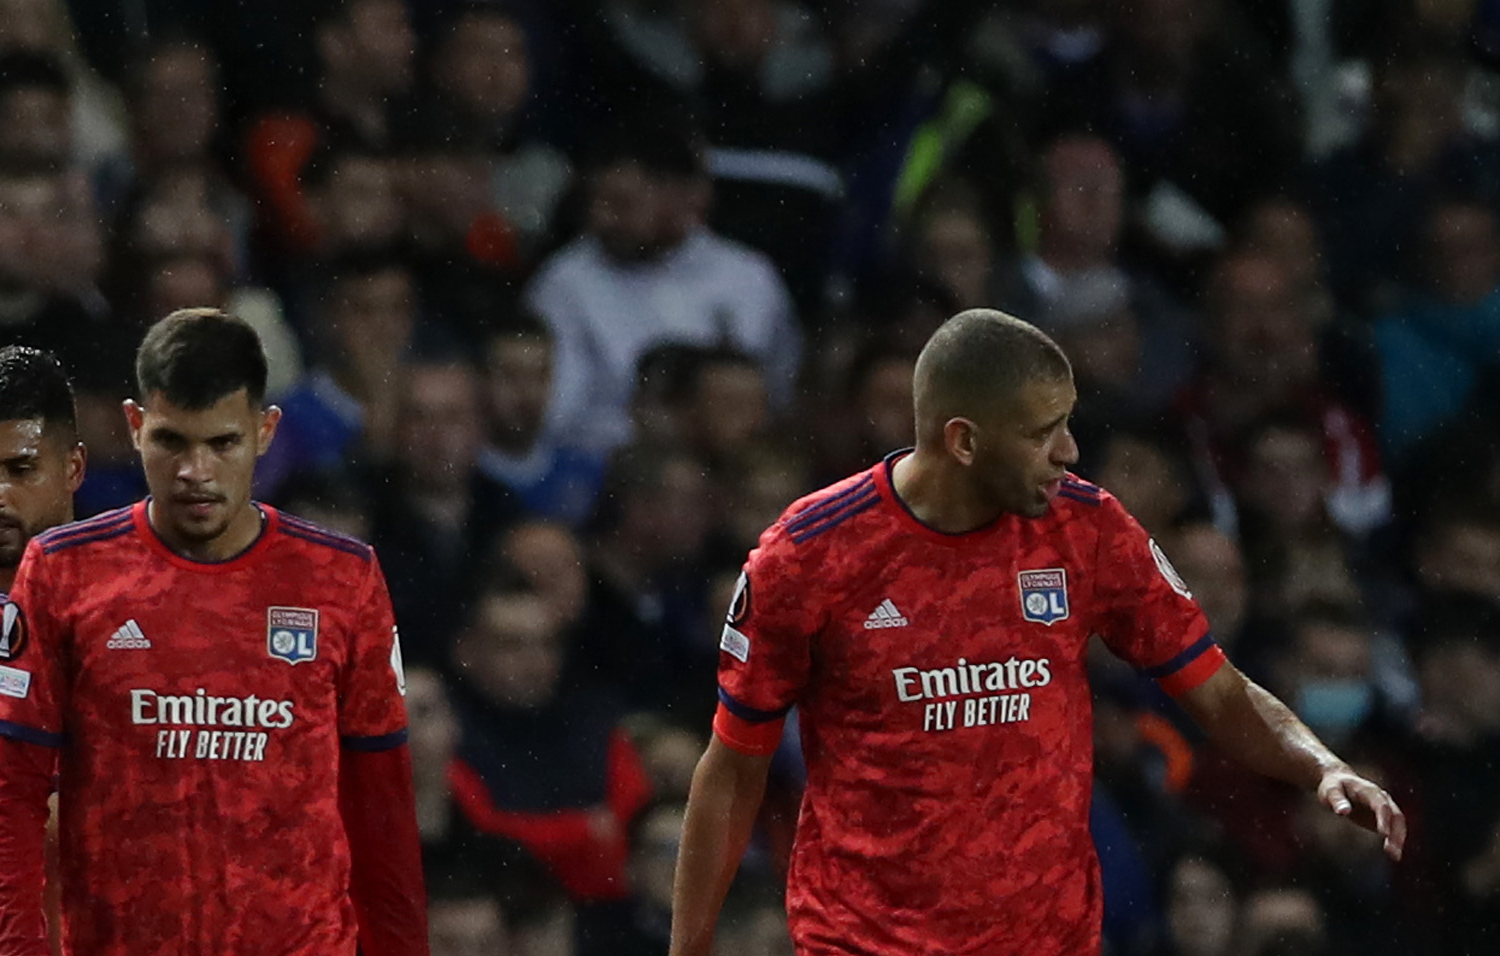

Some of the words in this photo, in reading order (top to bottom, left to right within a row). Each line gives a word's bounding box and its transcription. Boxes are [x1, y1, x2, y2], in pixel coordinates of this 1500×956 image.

[864, 616, 908, 630] adidas
[107, 638, 151, 650] adidas
[892, 656, 1051, 702] Emirates
[130, 688, 294, 728] Emirates
[924, 701, 957, 732] FLY
[964, 693, 1030, 727] BETTER
[156, 730, 191, 758] FLY
[195, 730, 268, 761] BETTER
